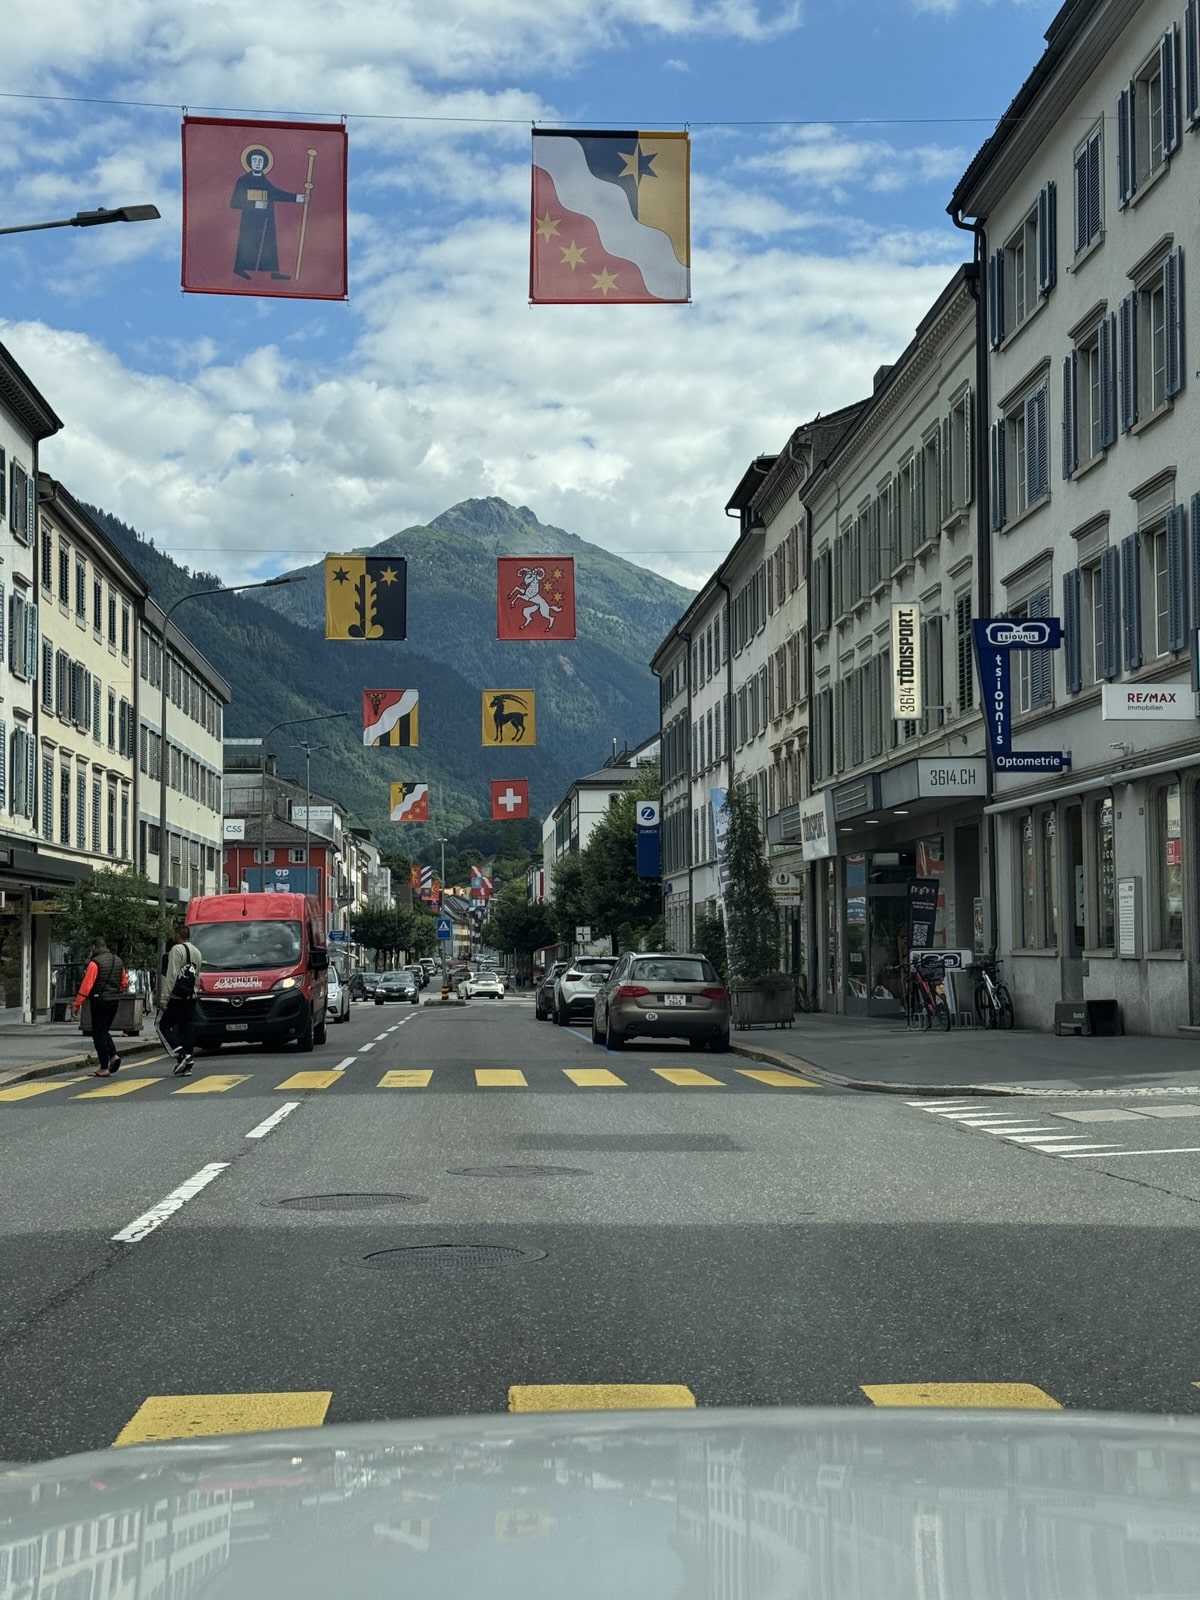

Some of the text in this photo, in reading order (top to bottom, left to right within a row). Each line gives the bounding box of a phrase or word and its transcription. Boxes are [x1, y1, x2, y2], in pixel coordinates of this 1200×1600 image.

[999, 632, 1037, 641] tsiounis
[897, 609, 915, 712] 3614 TÖDISPORT.
[994, 654, 1004, 745] tsiounis
[1127, 692, 1177, 703] RE/MAX
[996, 755, 1061, 768] Optometrie
[930, 768, 976, 786] 3614.CH
[226, 825, 242, 833] CSS
